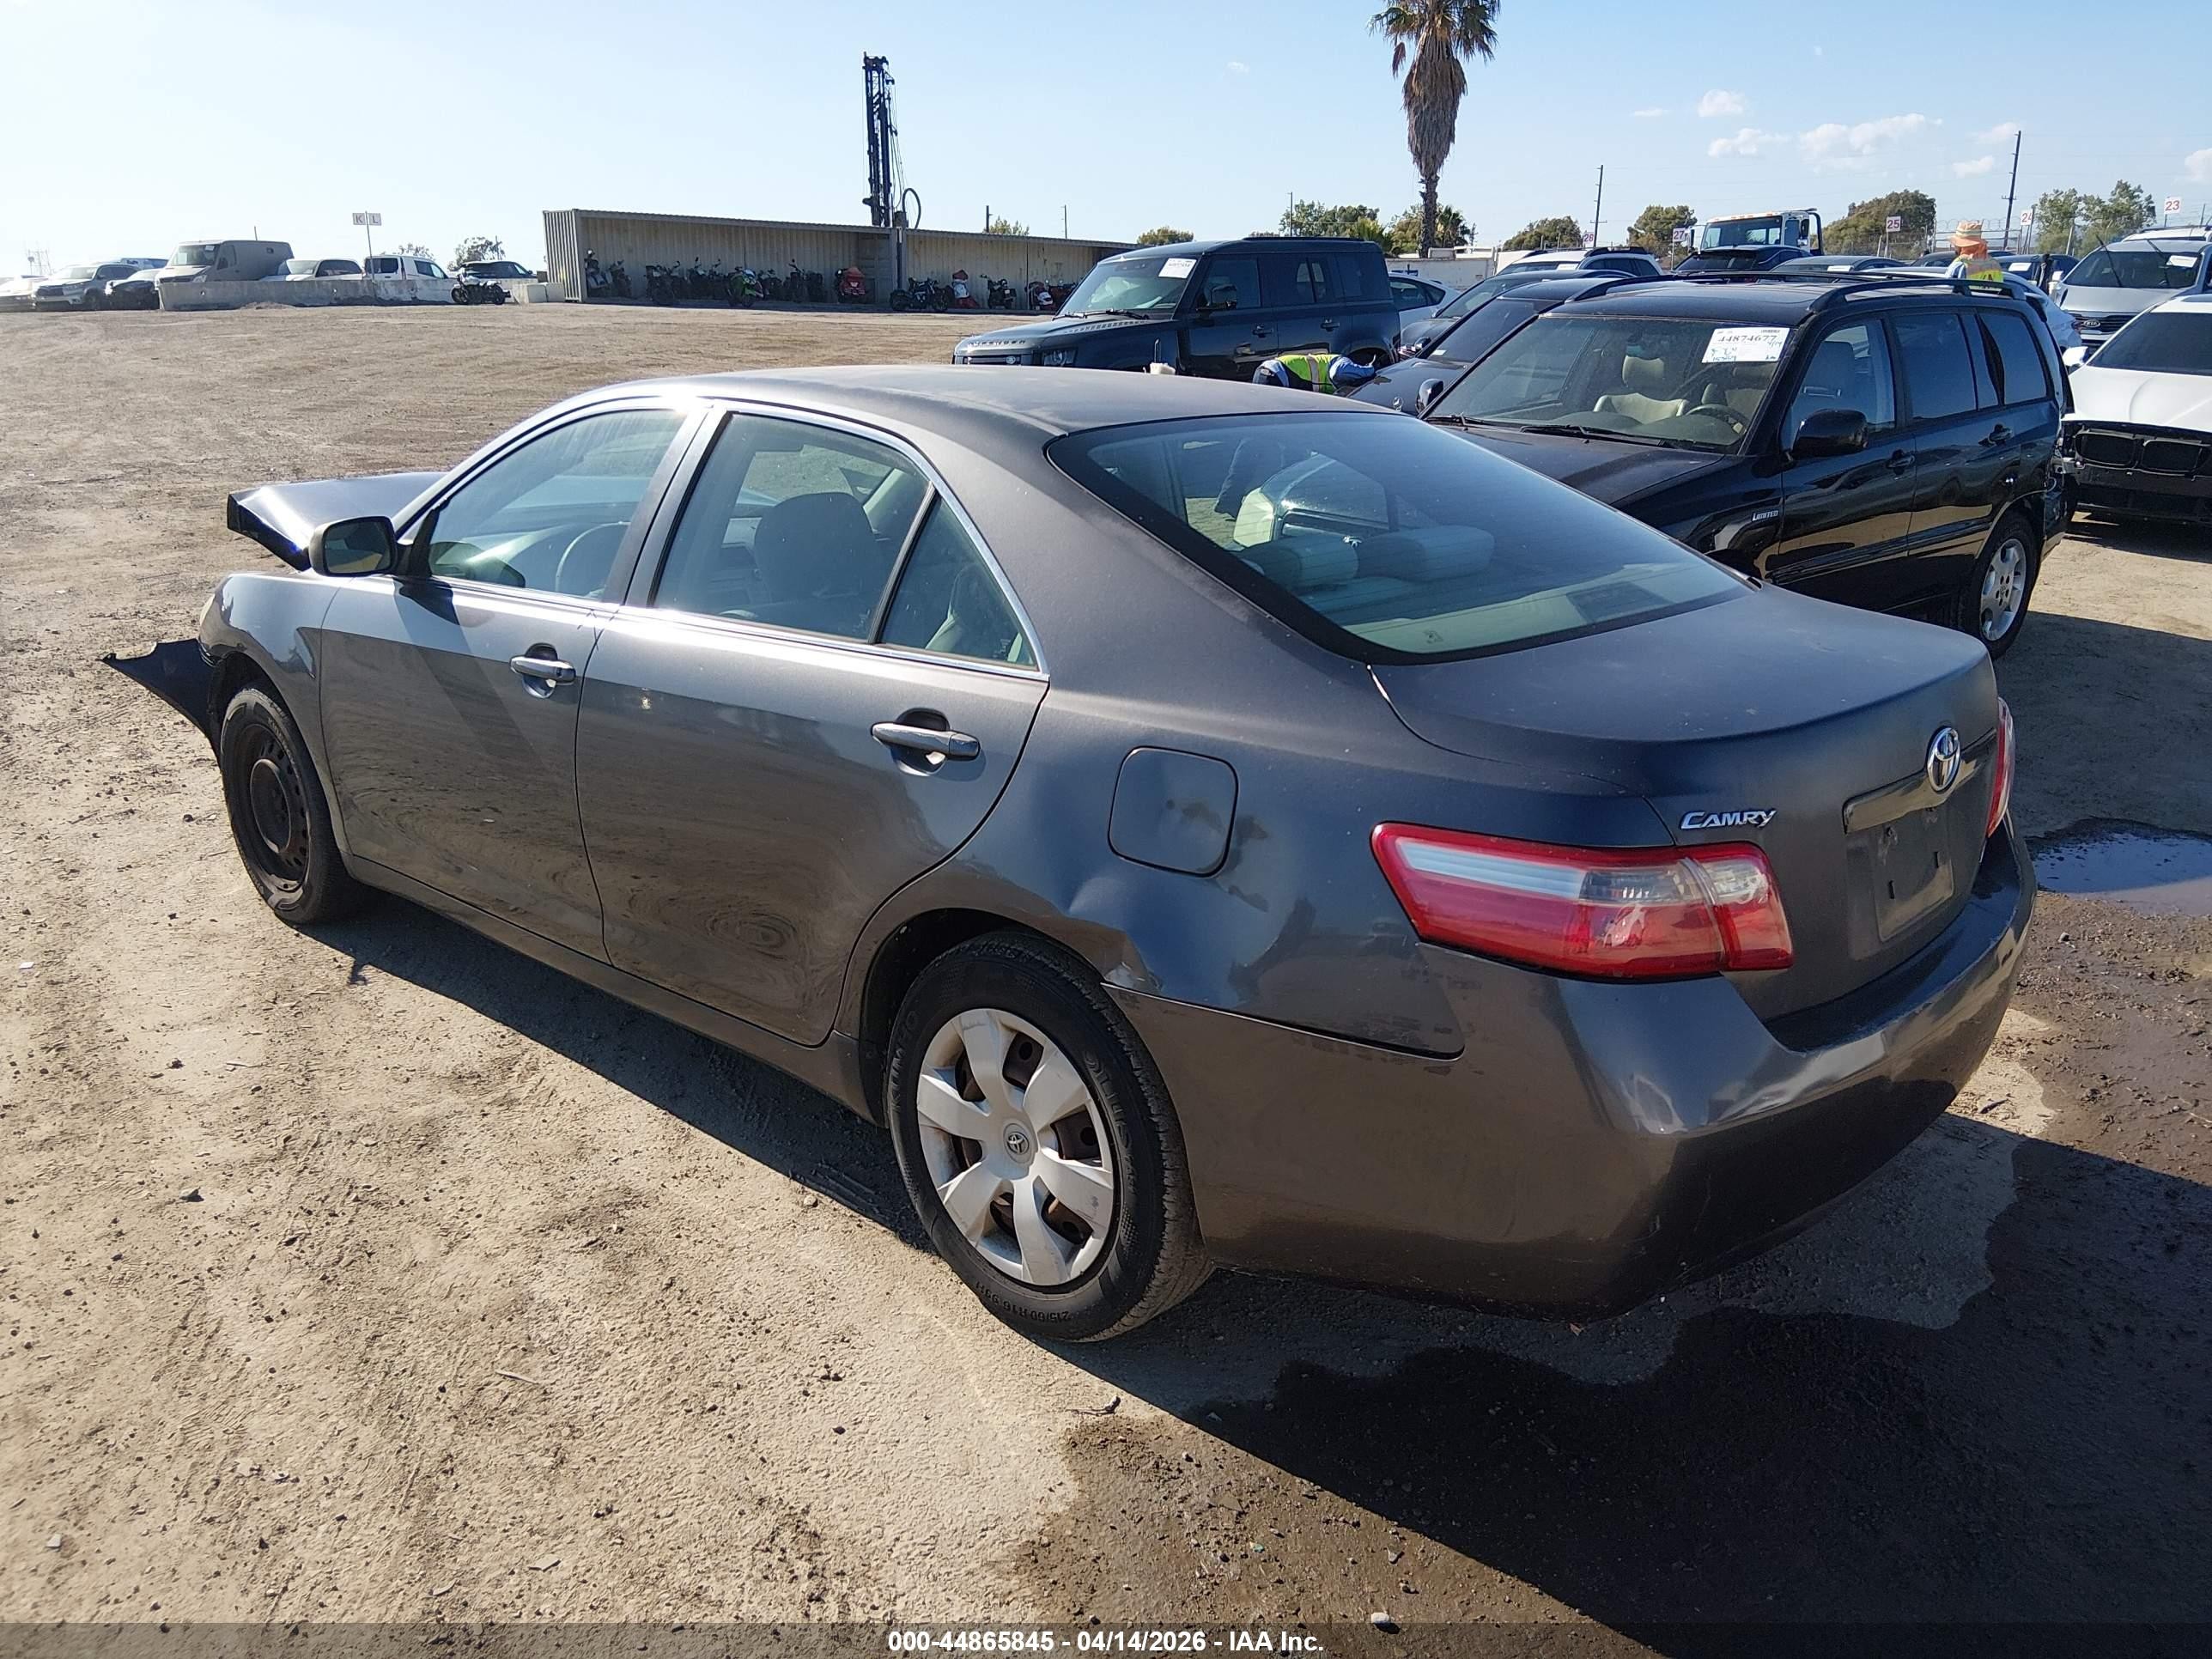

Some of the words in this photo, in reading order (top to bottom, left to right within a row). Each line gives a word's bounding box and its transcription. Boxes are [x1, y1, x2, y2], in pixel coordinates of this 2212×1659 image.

[2165, 200, 2179, 211] 23
[356, 215, 363, 223] K
[372, 215, 379, 224] L
[1887, 219, 1900, 229] 25
[1674, 231, 1684, 240] 27
[1680, 809, 1778, 830] CAMRY
